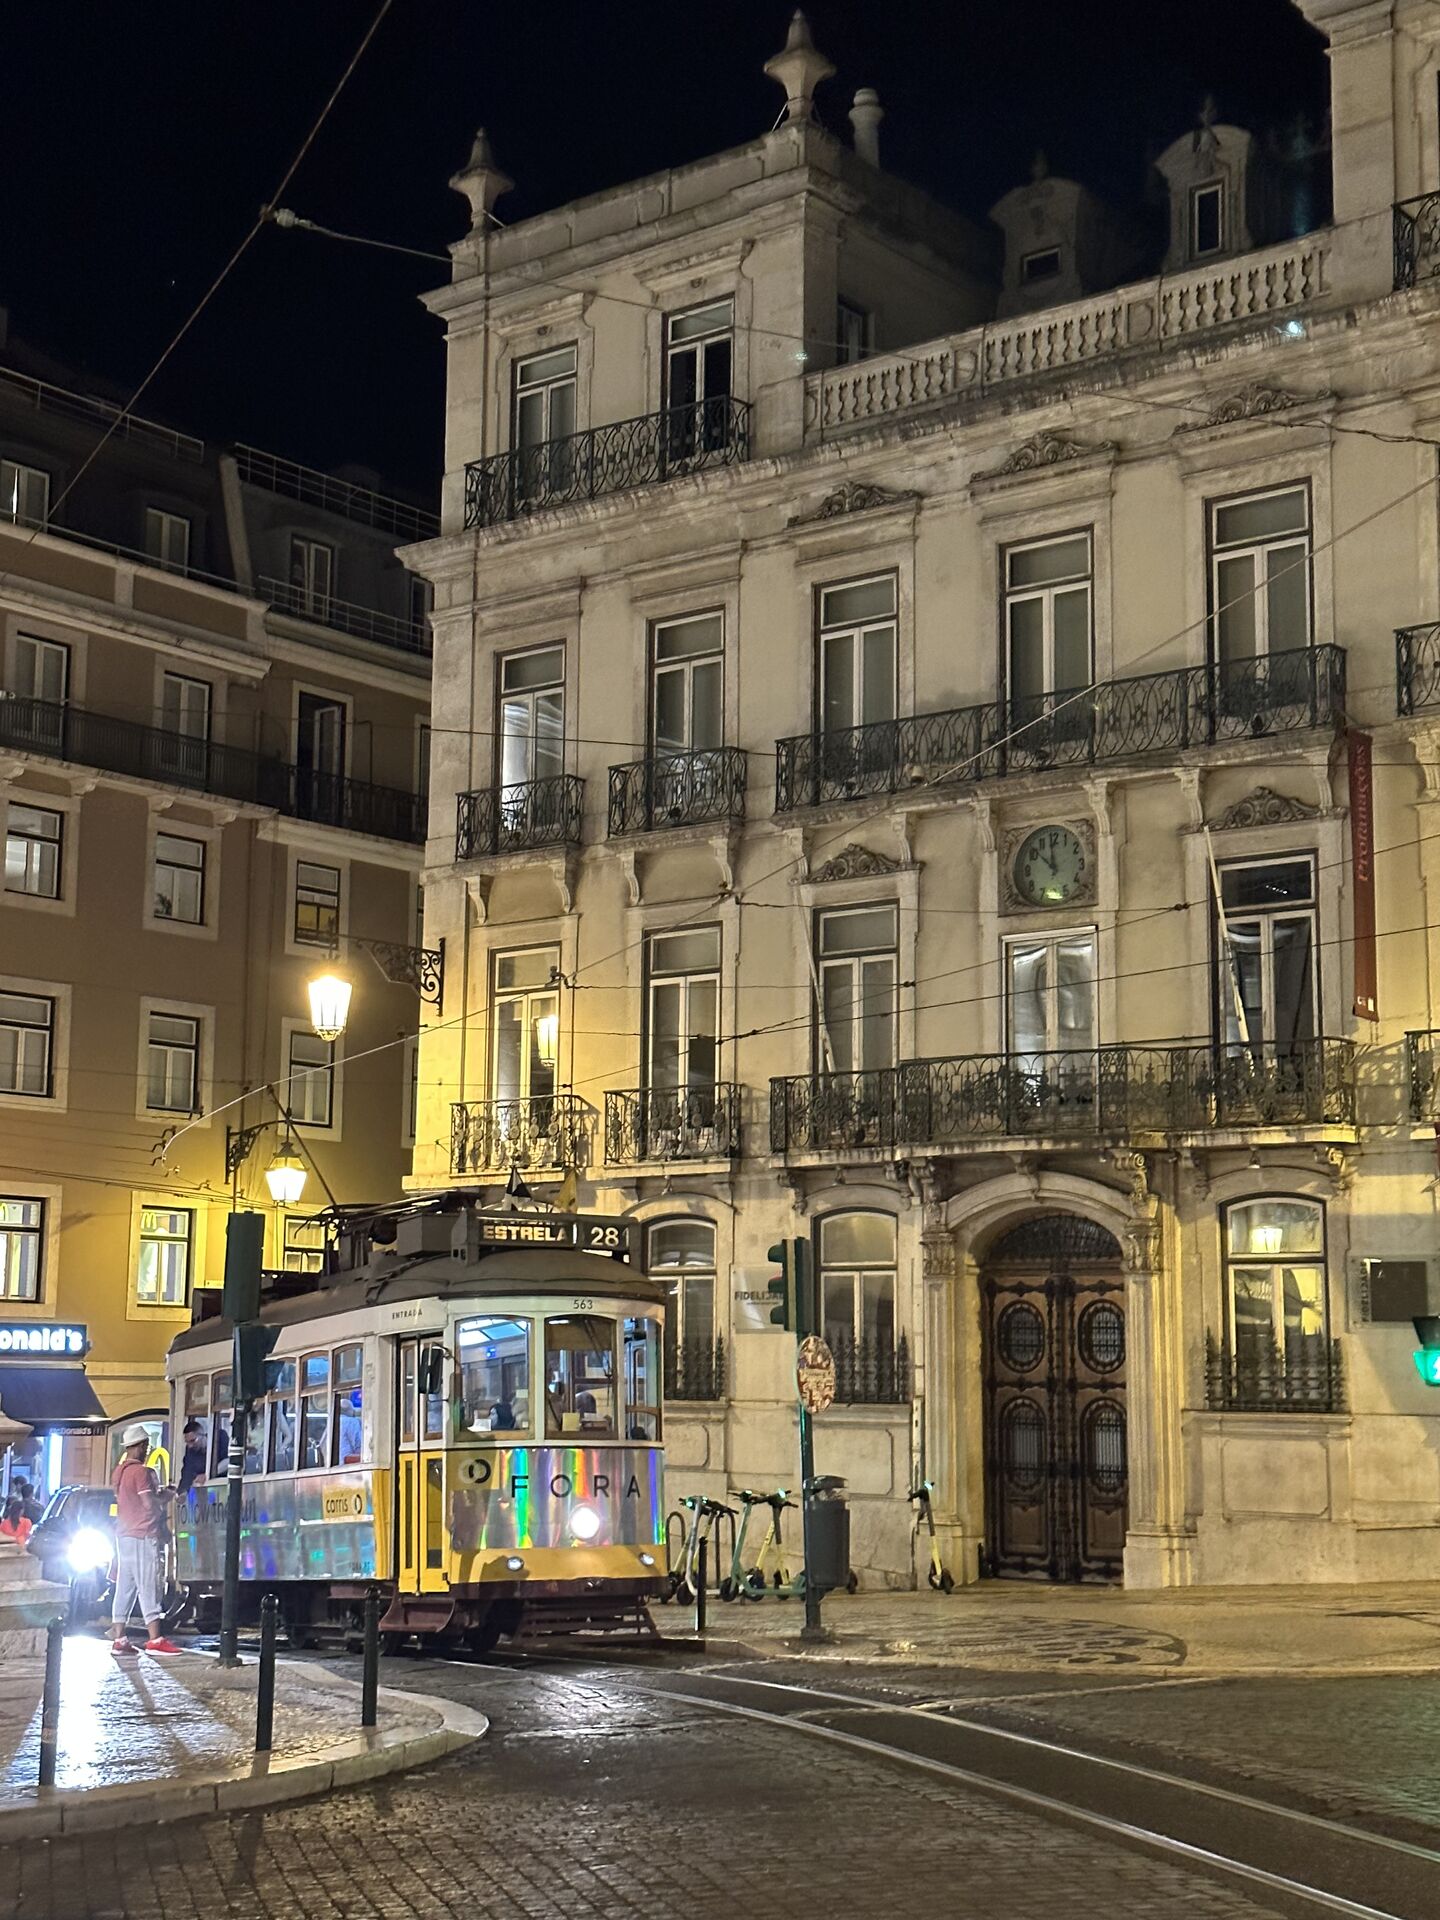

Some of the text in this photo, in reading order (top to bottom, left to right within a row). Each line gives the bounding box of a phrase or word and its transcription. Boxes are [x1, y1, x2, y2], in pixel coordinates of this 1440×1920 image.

[1072, 841, 1080, 855] 2
[1078, 858, 1085, 871] 3
[482, 1224, 568, 1242] ESTRELA
[573, 1300, 593, 1310] 563
[392, 1308, 423, 1320] ENTRADA
[511, 1474, 641, 1499] FORA
